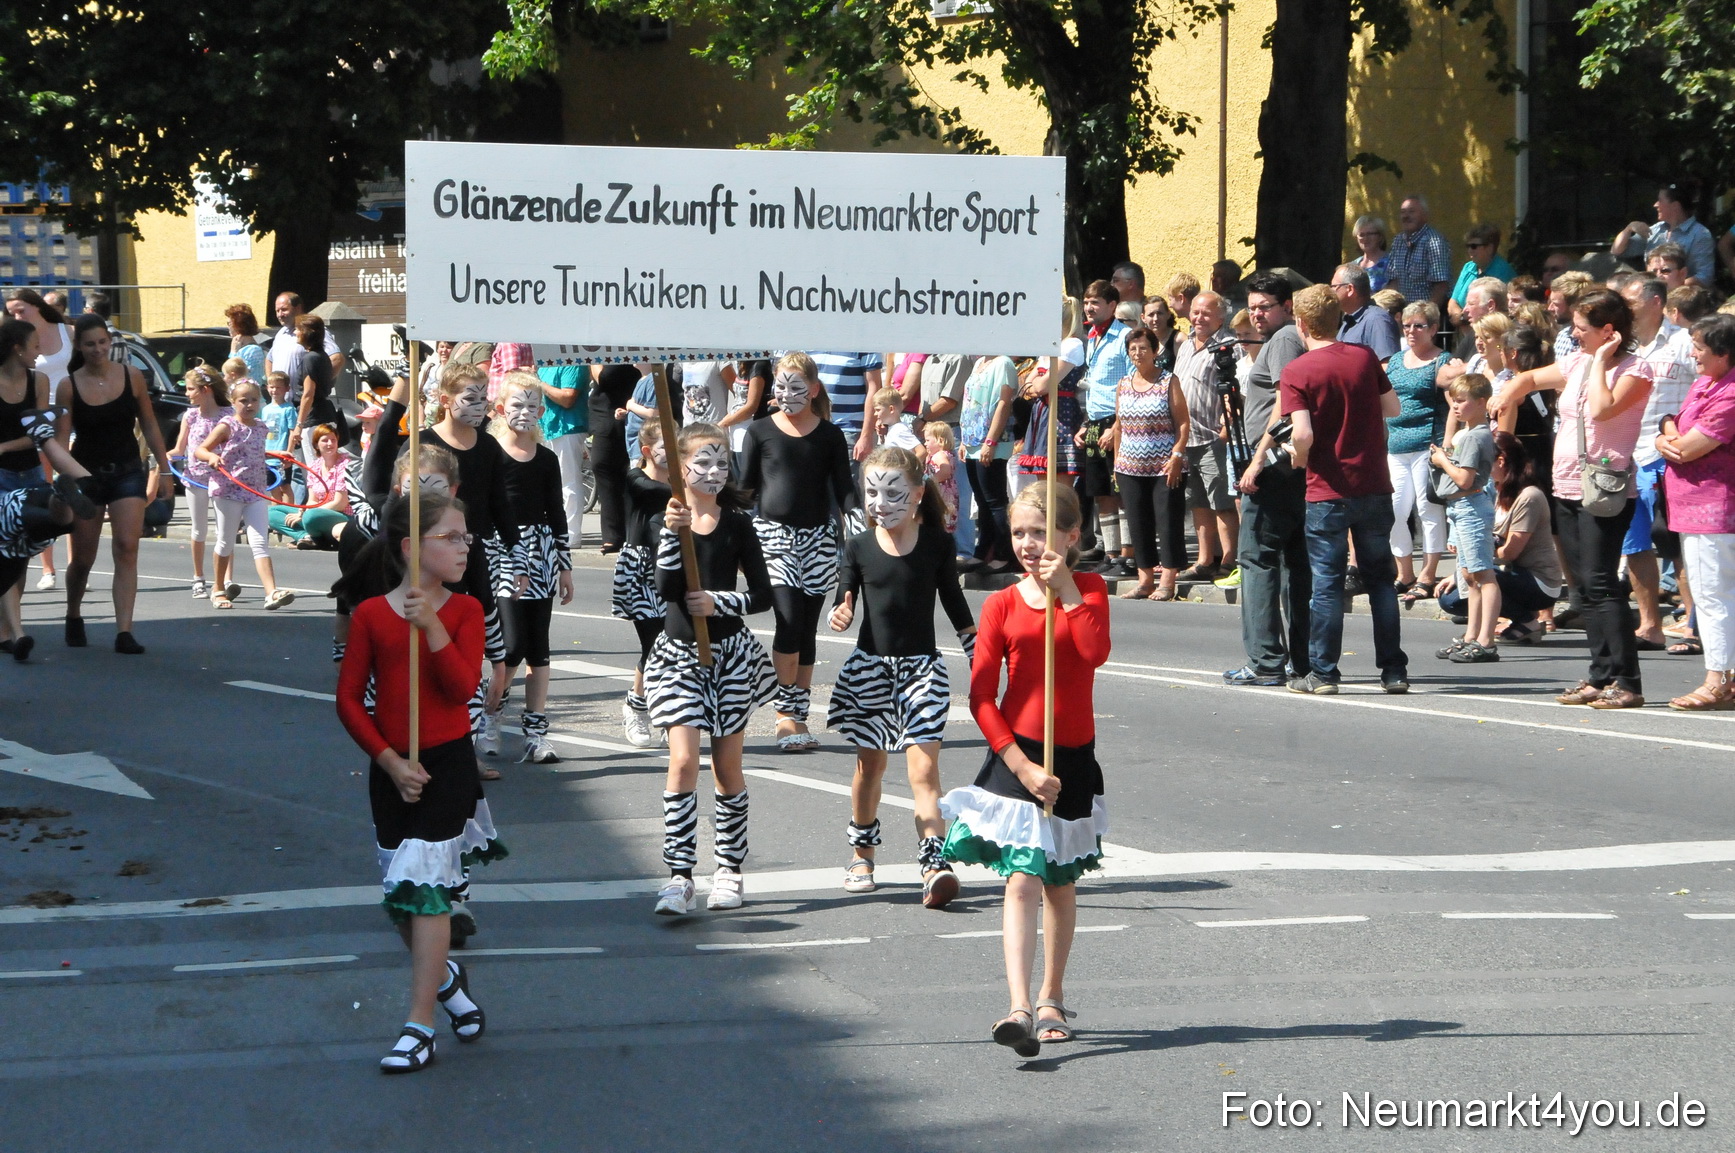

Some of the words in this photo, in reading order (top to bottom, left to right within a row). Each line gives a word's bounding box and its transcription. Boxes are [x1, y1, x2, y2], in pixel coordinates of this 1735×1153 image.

[433, 178, 602, 224] Glänzende
[604, 182, 739, 235] Zukunft
[749, 189, 785, 229] im
[794, 186, 960, 233] Neumarkter
[962, 191, 1040, 245] Sport
[328, 234, 386, 260] usfahrt
[358, 264, 407, 293] freiha
[450, 262, 547, 305] Unsere
[552, 264, 707, 310] Turnküken
[720, 284, 745, 310] u.
[759, 270, 1027, 317] Nachwuchstrainer
